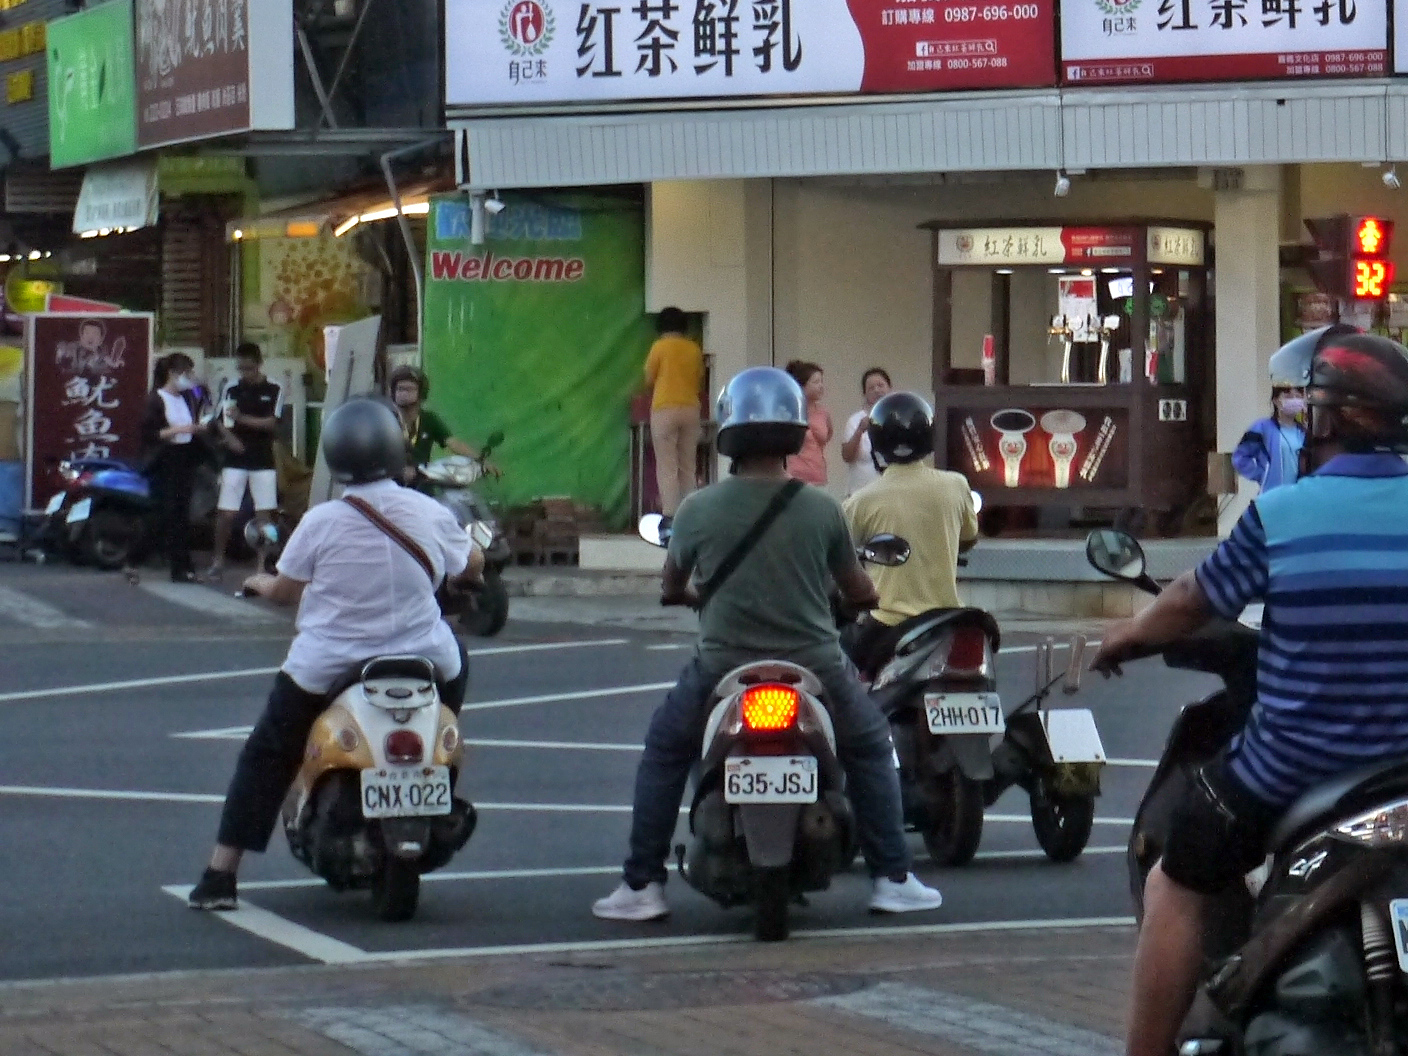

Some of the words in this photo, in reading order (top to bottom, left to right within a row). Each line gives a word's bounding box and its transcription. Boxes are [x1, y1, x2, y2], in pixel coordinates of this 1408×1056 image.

[881, 8, 935, 26] 訂購專線
[944, 4, 1038, 23] 0987-696-000
[947, 58, 1007, 70] 0800-567-088
[431, 249, 585, 282] Welcome
[1353, 259, 1386, 298] 32
[364, 782, 448, 810] CNX-022
[728, 772, 815, 795] 635-JSJ
